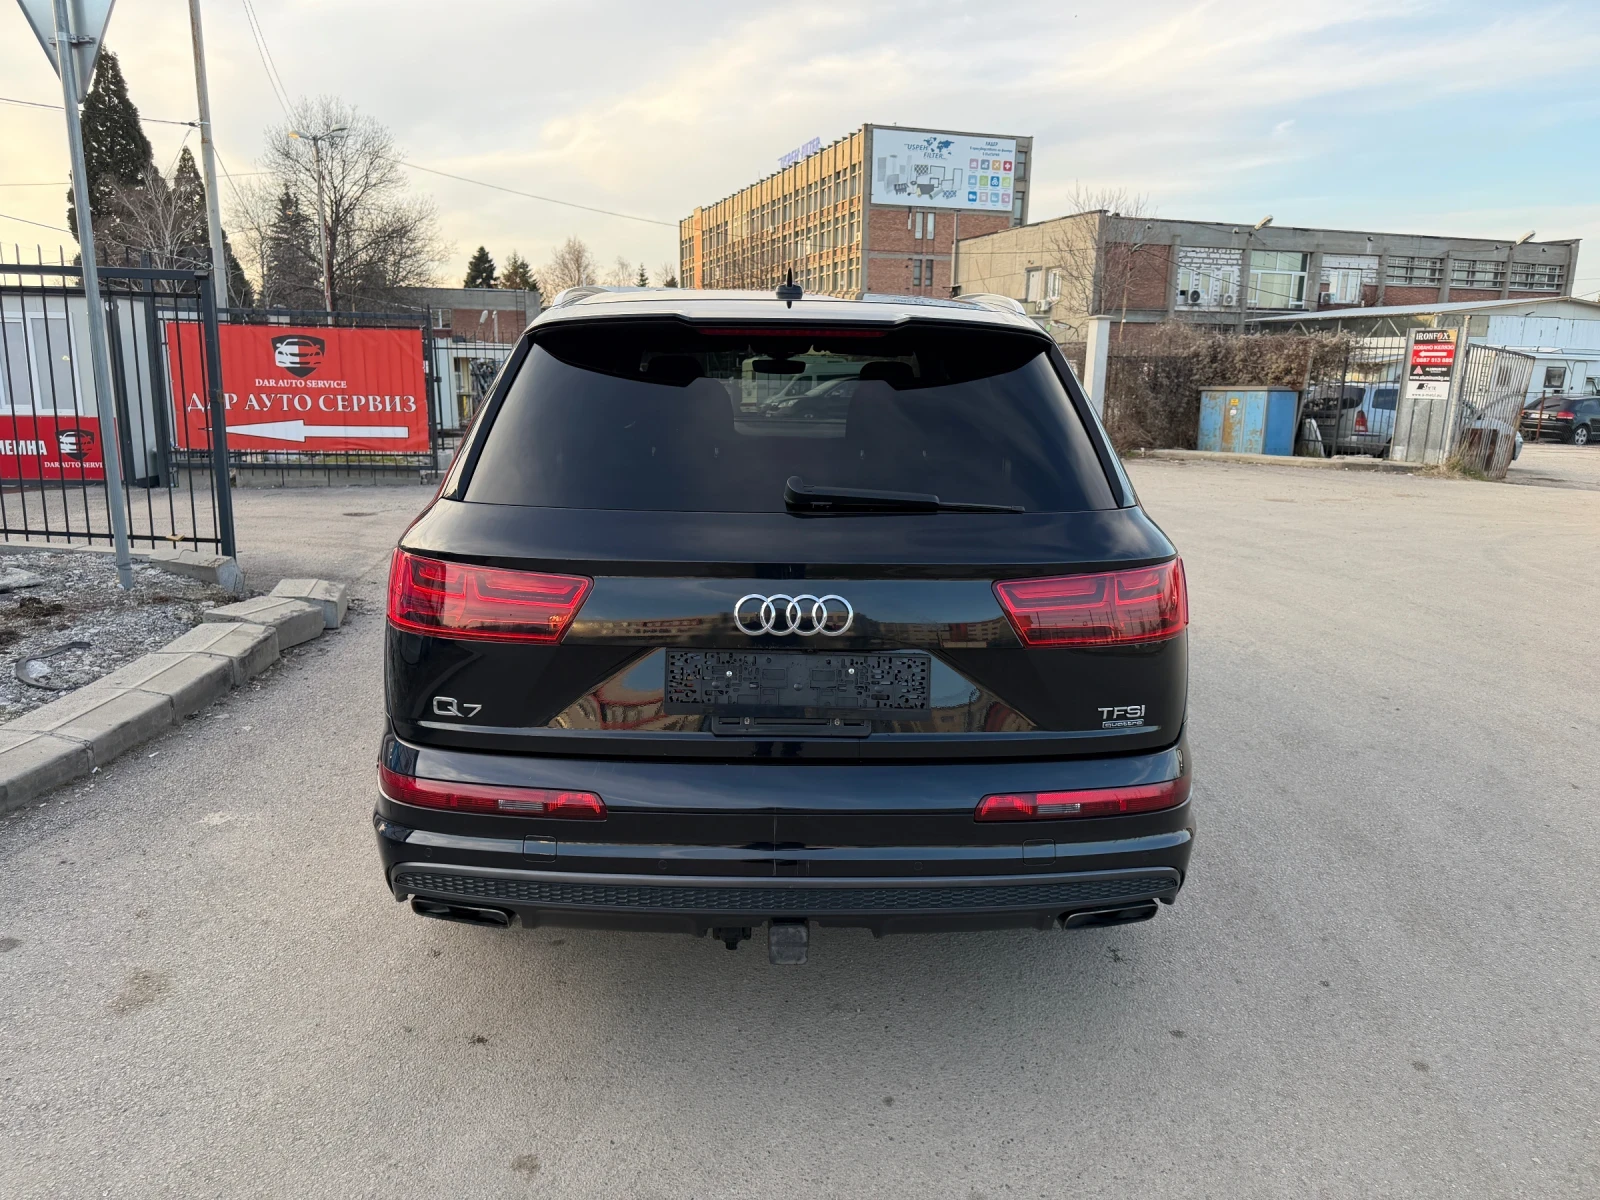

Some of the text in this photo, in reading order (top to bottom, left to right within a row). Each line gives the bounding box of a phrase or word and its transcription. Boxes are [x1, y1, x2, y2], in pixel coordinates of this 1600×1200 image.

[904, 143, 928, 151] USPEH
[1416, 332, 1449, 340] IRONFOX
[255, 378, 347, 389] DAR AUTO SERVICE
[187, 392, 417, 413] ДР АУТО СЕРВИЗ
[82, 461, 103, 469] SERVI
[433, 696, 482, 718] Q7
[1097, 704, 1146, 720] TFSI
[1104, 720, 1143, 728] quattro
